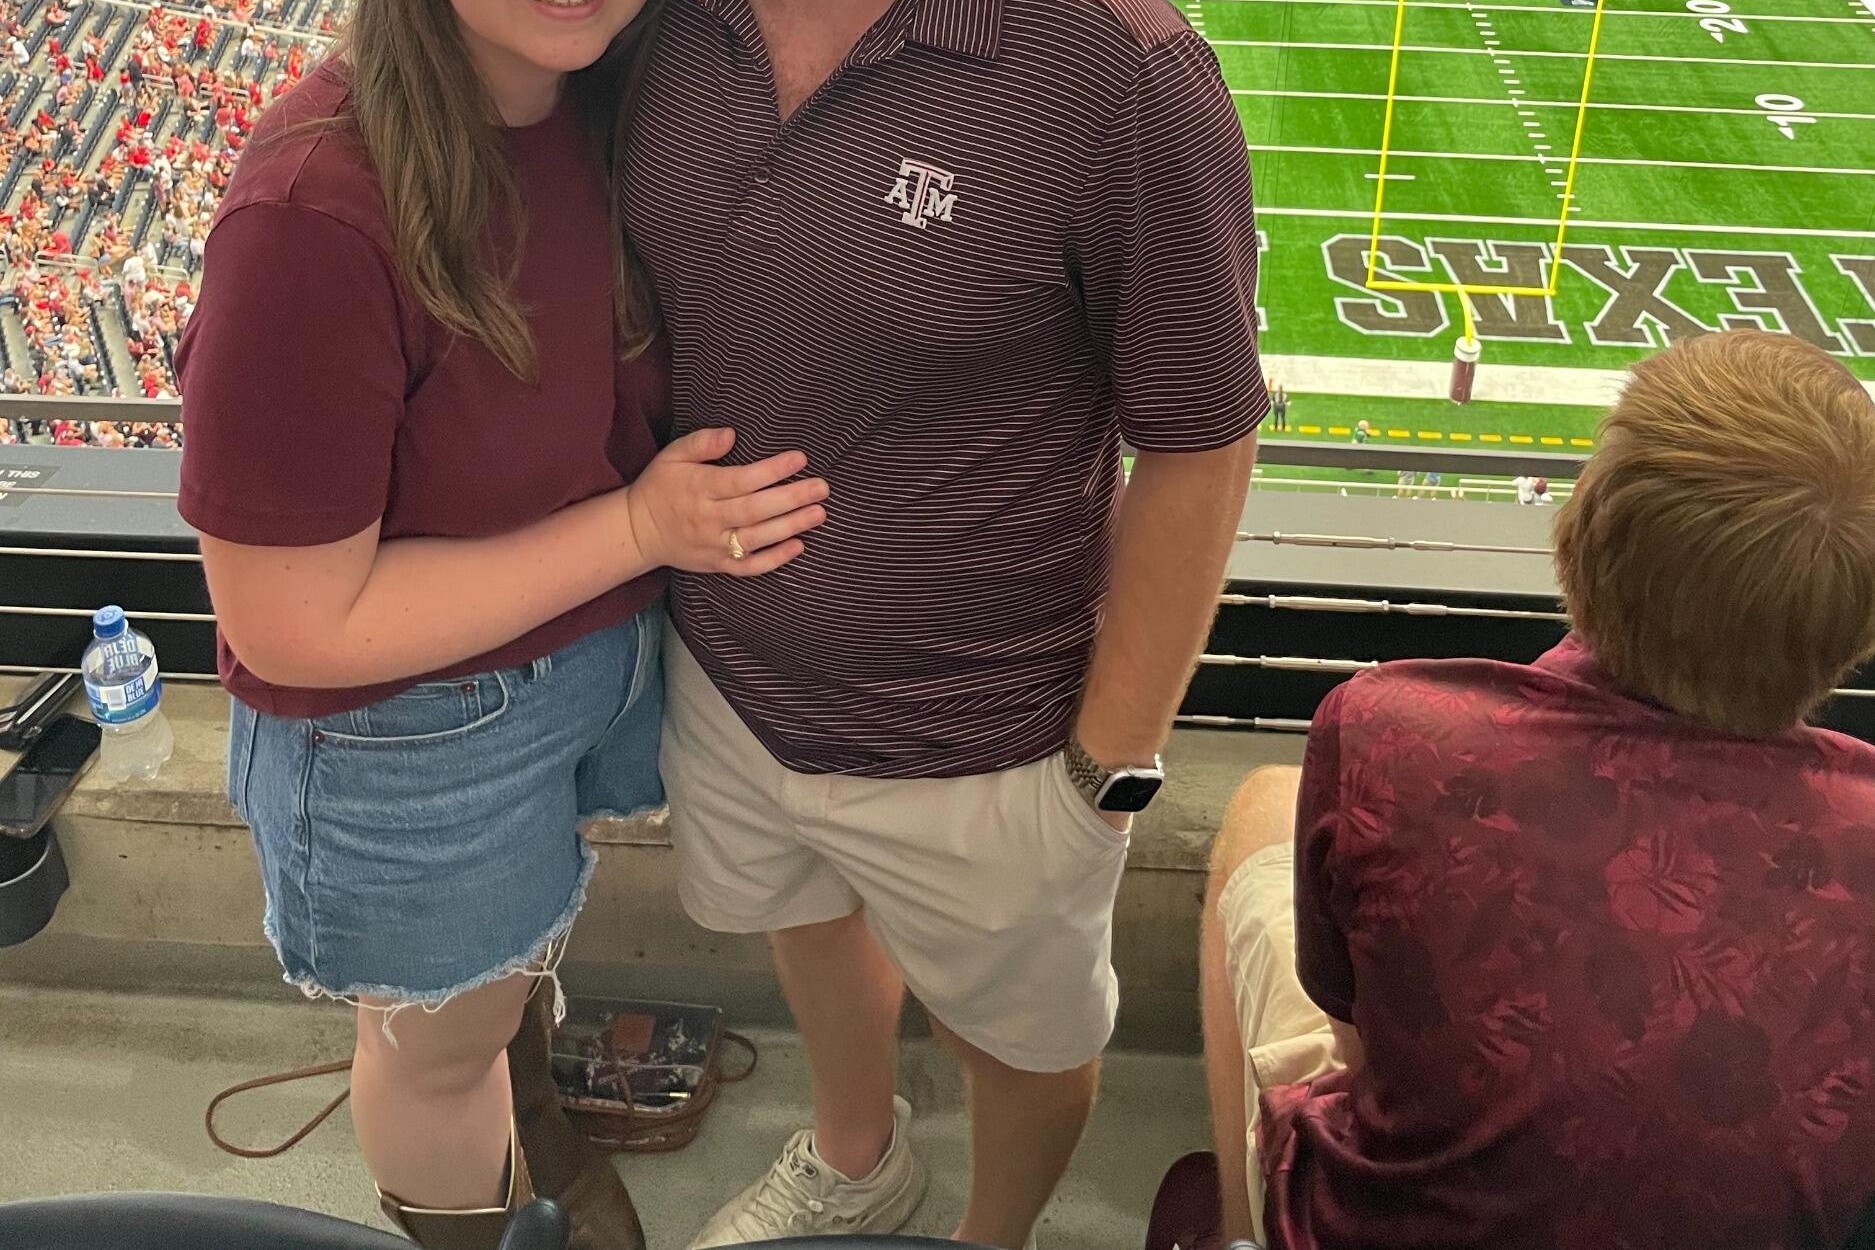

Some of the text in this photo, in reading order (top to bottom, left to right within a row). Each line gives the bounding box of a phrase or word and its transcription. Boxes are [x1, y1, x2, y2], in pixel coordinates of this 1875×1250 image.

[1685, 0, 1749, 34] 20
[1754, 93, 1817, 124] 10
[7, 469, 41, 479] THIS
